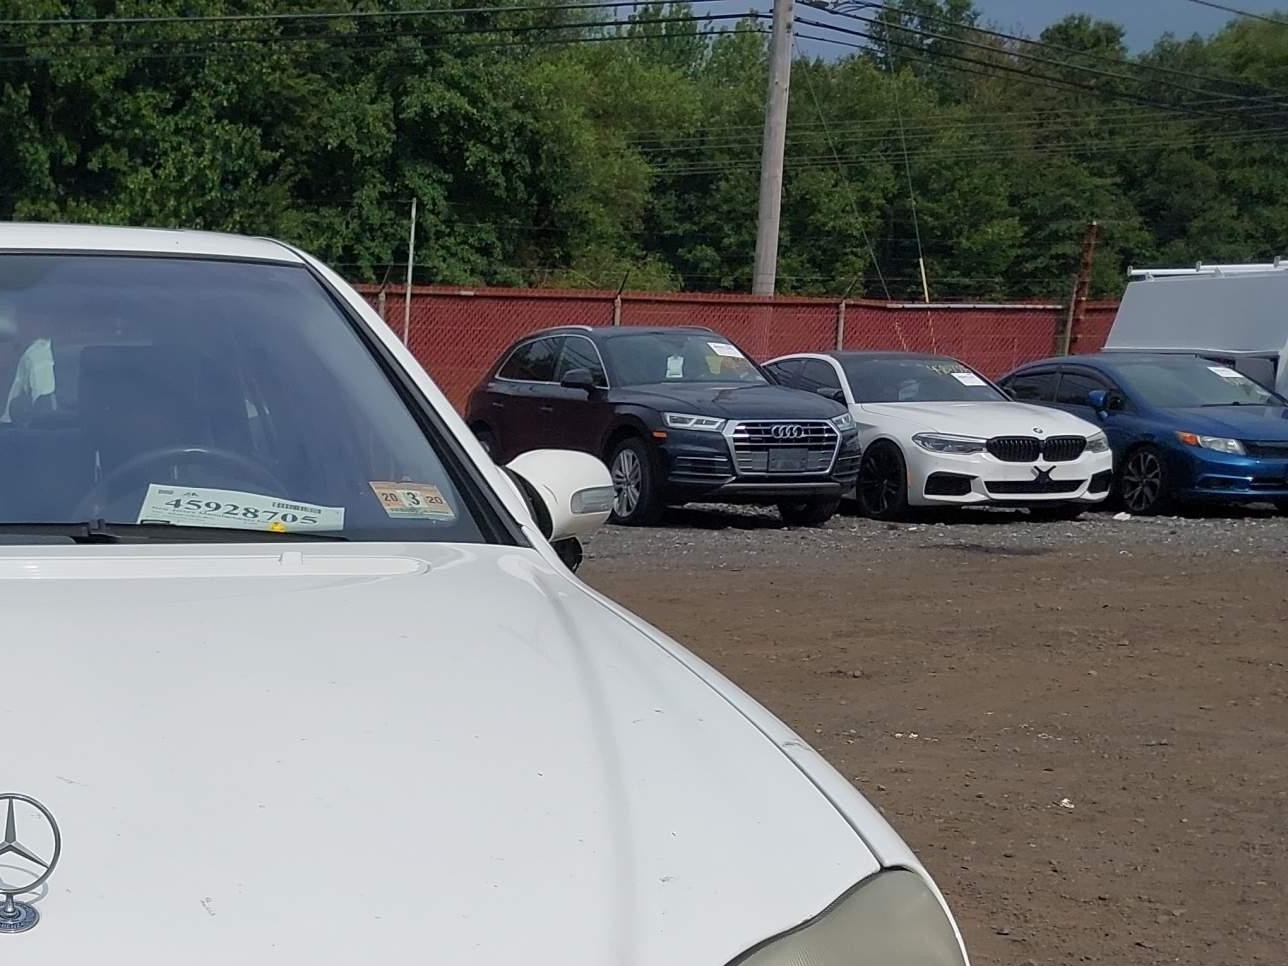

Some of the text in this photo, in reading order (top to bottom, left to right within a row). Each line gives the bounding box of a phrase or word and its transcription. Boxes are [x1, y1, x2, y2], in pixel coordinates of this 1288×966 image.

[381, 491, 444, 506] 20 3 20
[165, 499, 318, 524] 45928705
